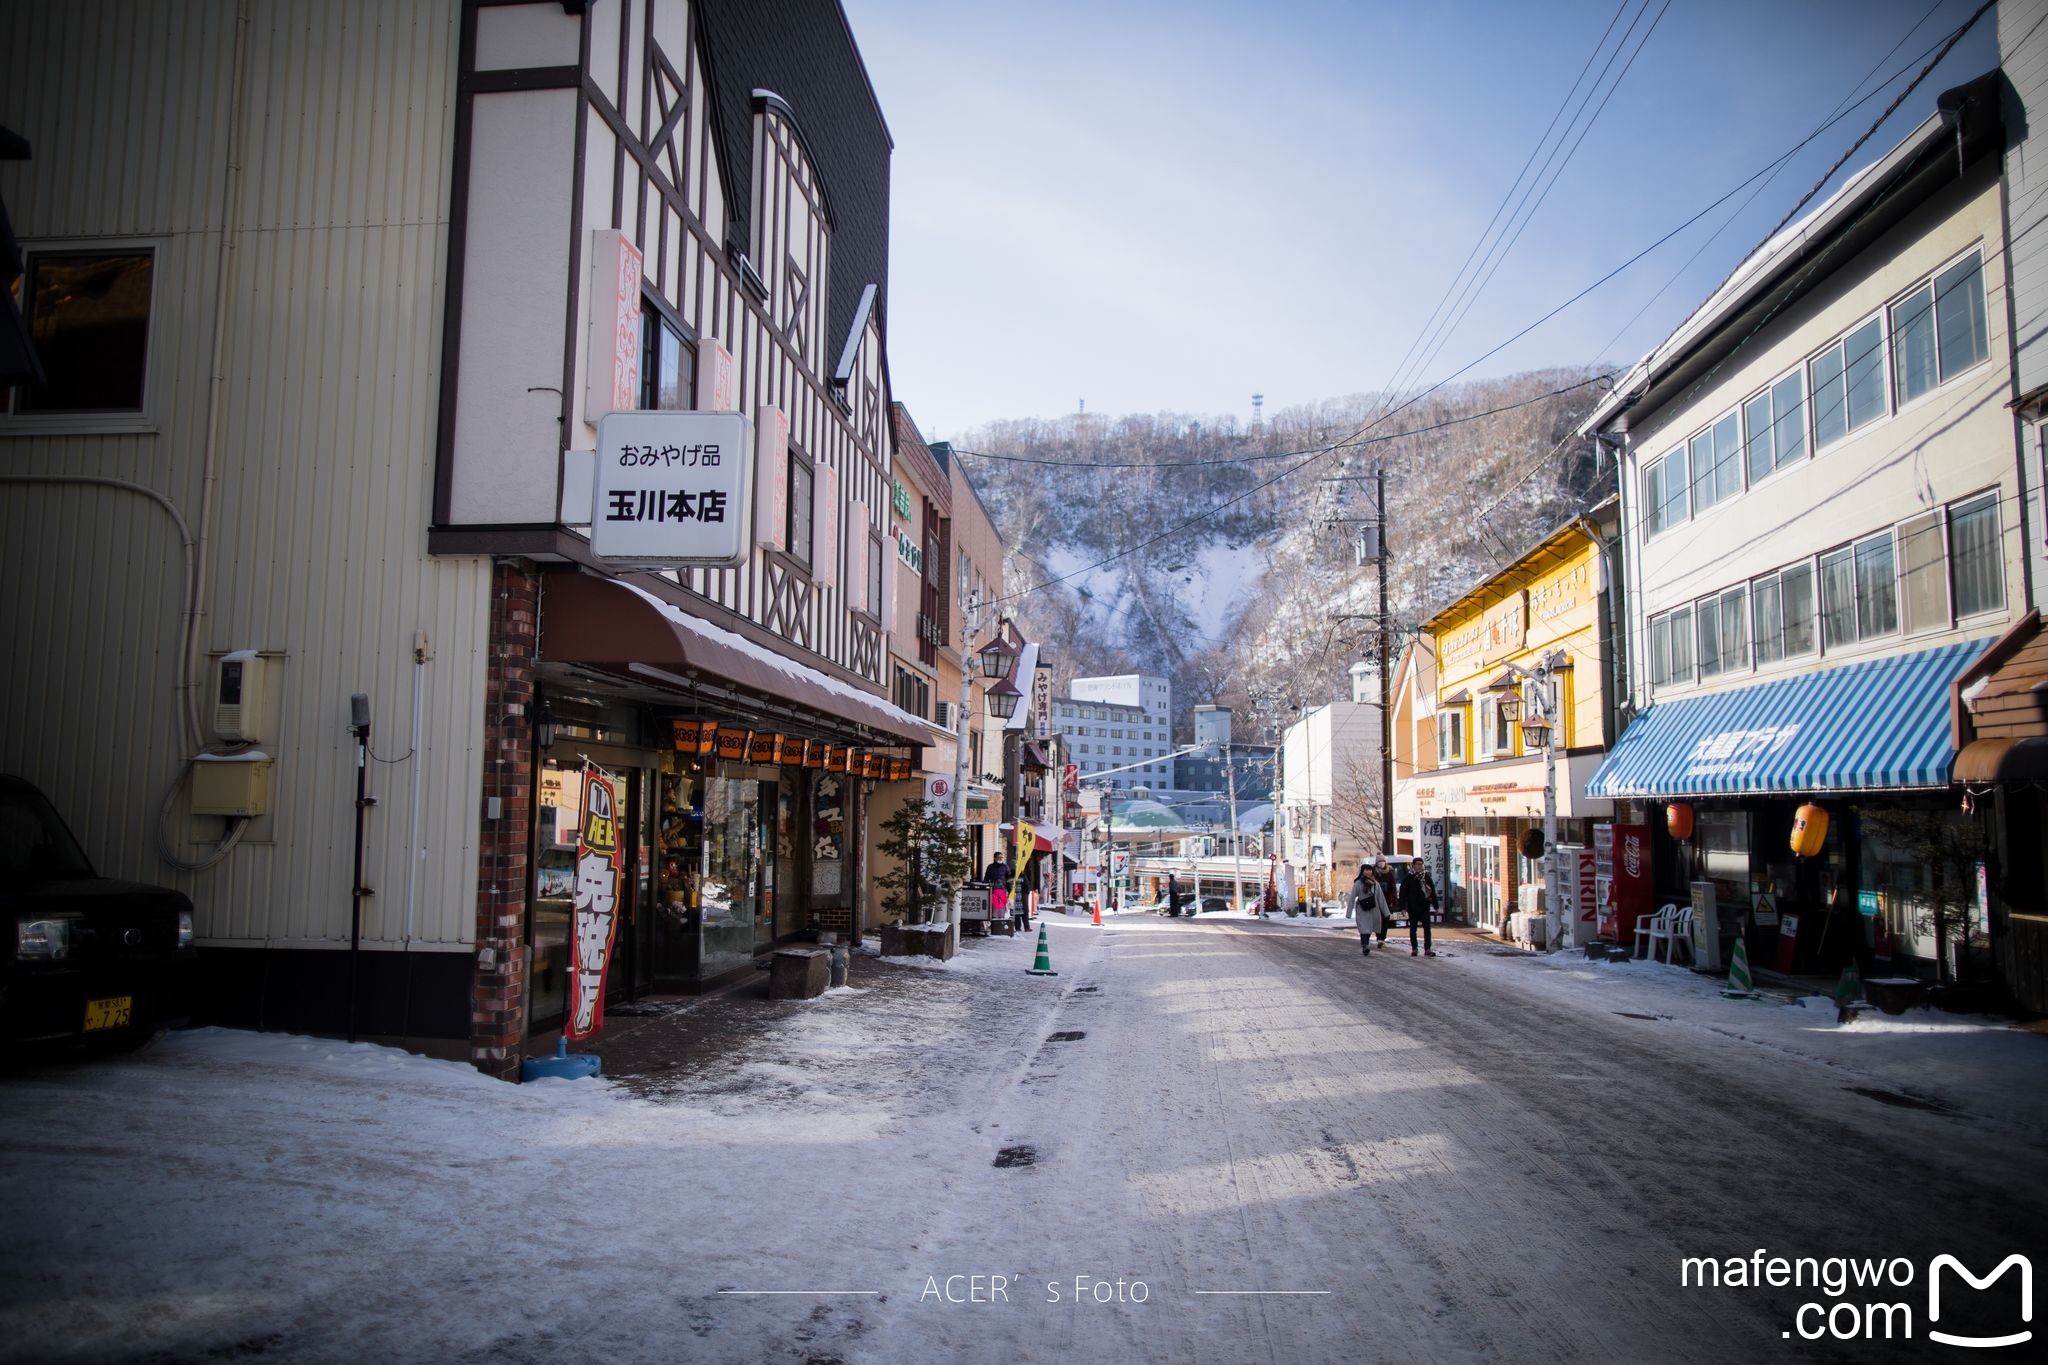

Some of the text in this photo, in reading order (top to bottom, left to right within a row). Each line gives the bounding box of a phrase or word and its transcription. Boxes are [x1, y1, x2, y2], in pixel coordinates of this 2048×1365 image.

[619, 444, 721, 467] おみやげ品
[606, 489, 727, 523] 玉川本店
[1037, 672, 1048, 721] みやげ専門
[1688, 724, 1800, 761] 大黒屋プラザ
[1424, 820, 1444, 838] 酒
[1624, 833, 1640, 879] Coca-Cola
[1580, 854, 1596, 921] KIRIN
